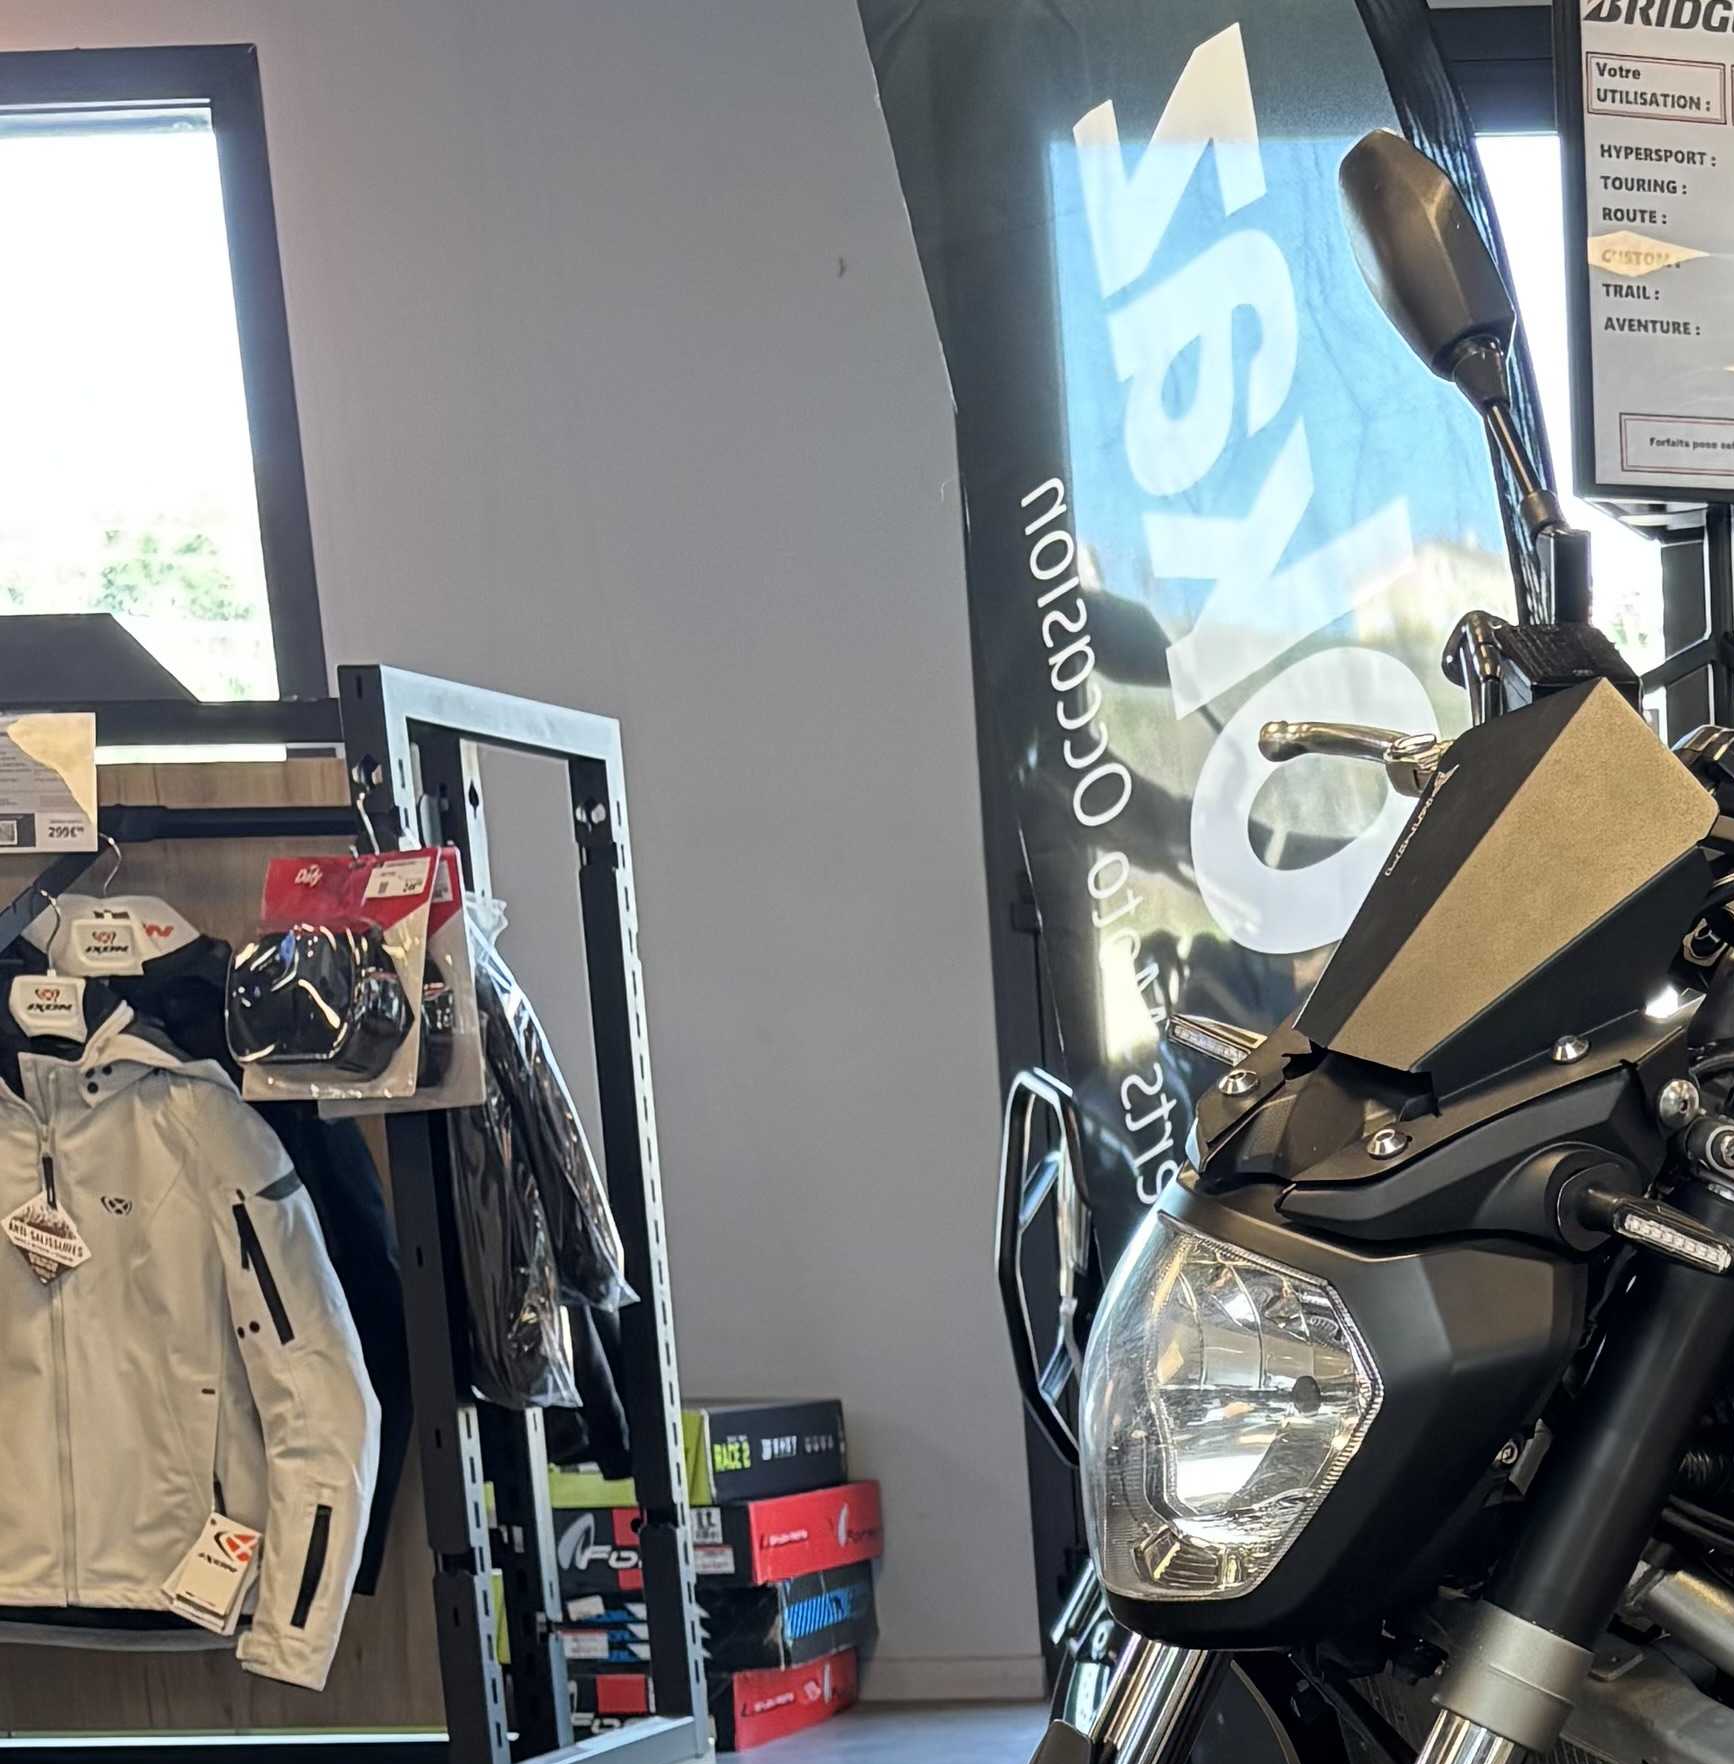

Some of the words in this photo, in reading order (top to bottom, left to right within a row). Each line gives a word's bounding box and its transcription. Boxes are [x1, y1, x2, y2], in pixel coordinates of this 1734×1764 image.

[1596, 62, 1641, 80] Votre
[1596, 87, 1701, 111] UTILISATION
[1600, 144, 1706, 166] HYPERSPORT
[1600, 175, 1678, 195] TOURING
[1602, 207, 1658, 224] ROUTE
[1602, 283, 1650, 300] TRAIL
[1604, 317, 1692, 336] AVENTURE
